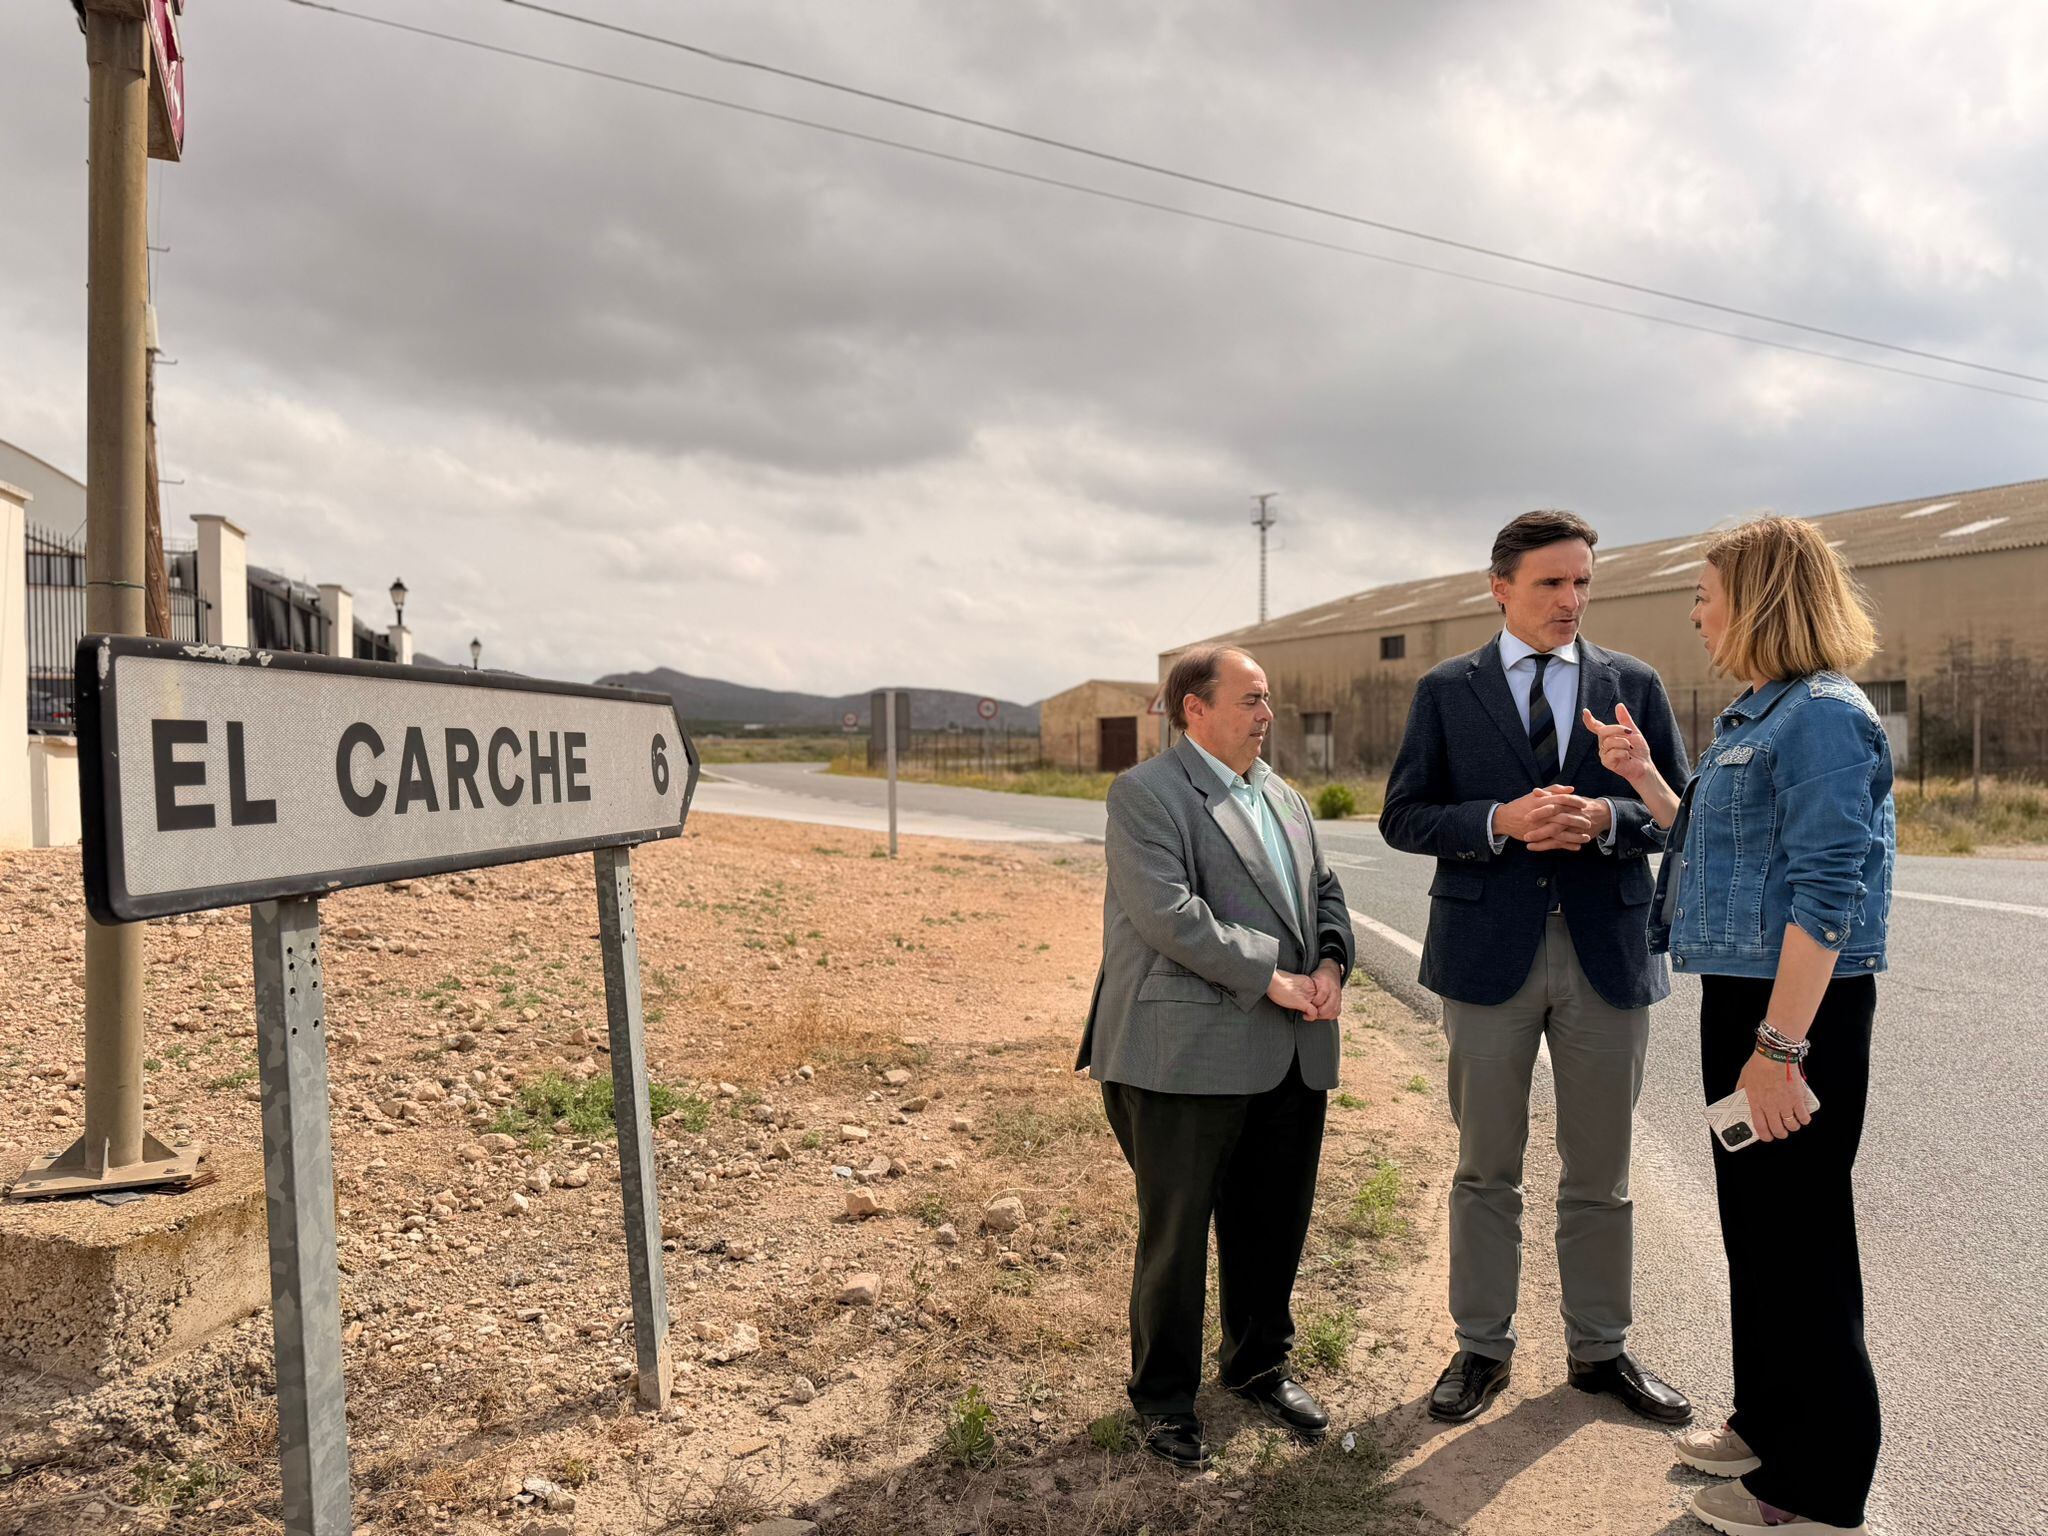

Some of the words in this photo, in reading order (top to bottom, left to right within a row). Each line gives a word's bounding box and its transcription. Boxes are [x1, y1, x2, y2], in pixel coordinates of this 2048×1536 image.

[151, 719, 277, 831] EL
[336, 722, 591, 817] CARCHE
[651, 733, 669, 795] 6
